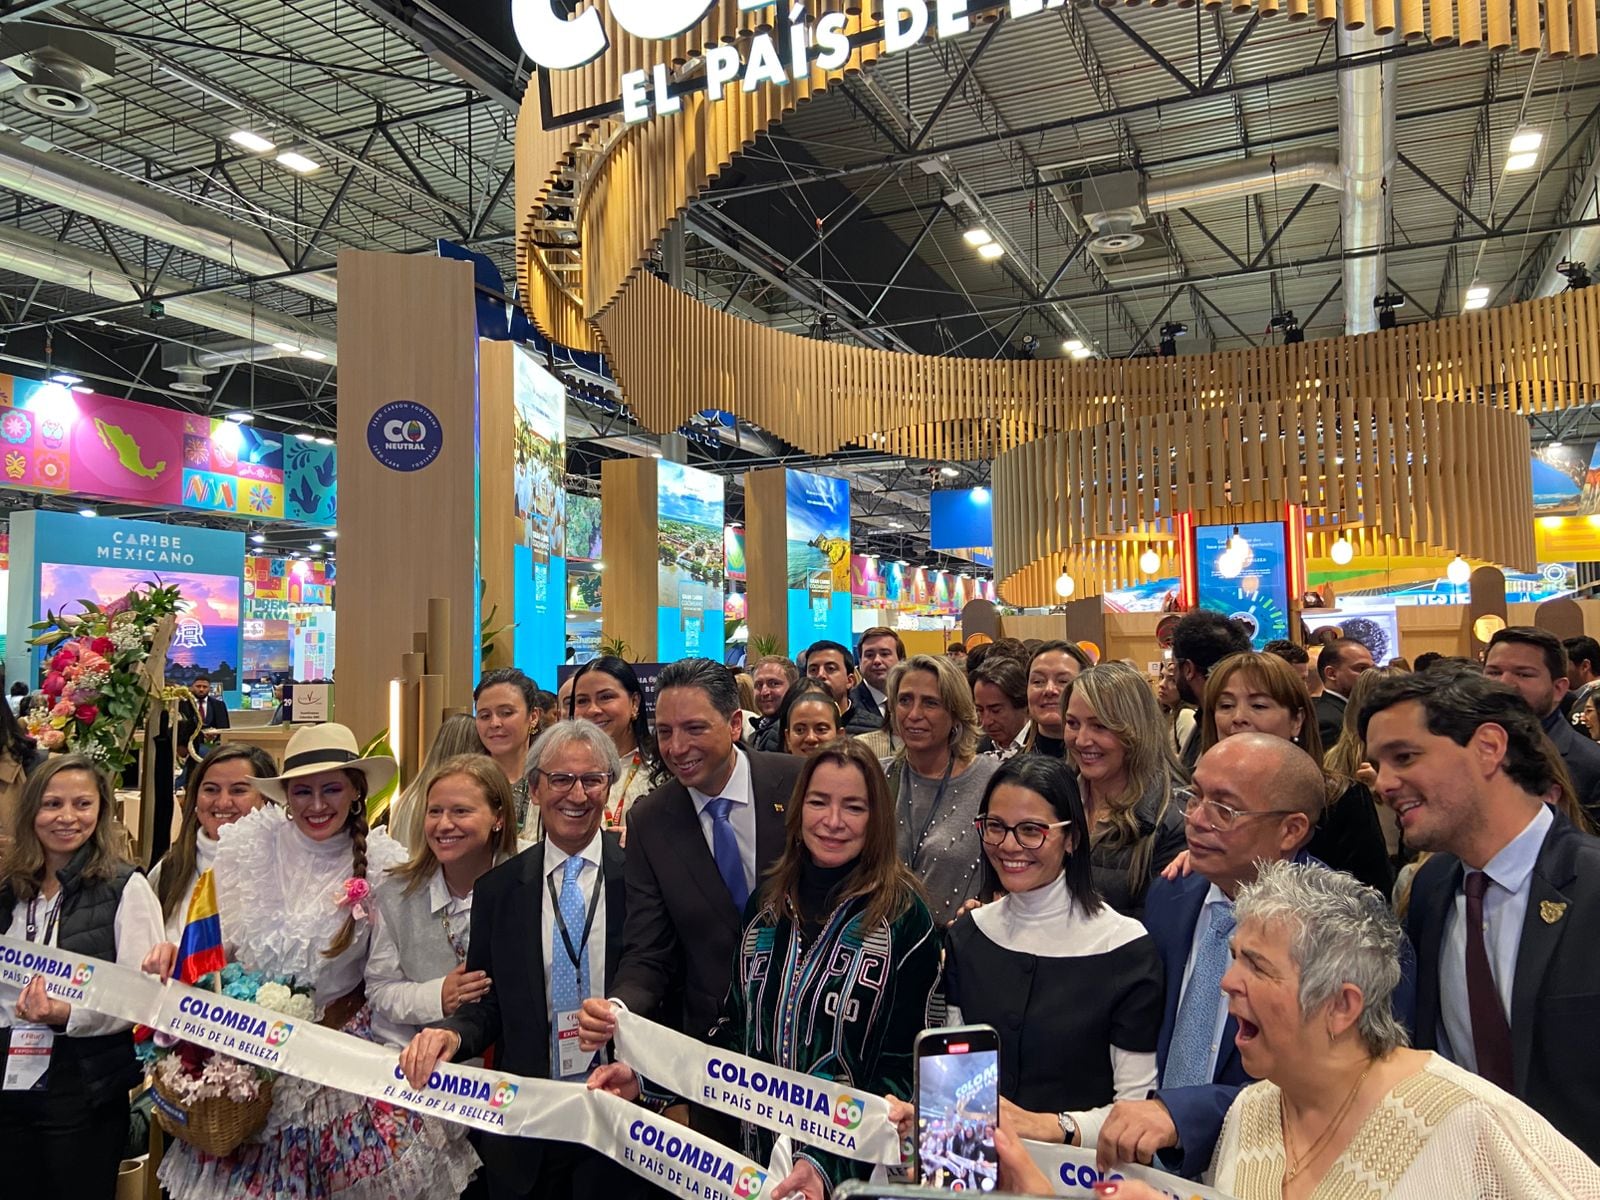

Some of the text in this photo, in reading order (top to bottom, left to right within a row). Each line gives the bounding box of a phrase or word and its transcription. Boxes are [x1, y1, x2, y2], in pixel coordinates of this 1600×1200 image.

[621, 63, 682, 123] EL
[705, 2, 850, 101] PAÍS
[882, 0, 970, 54] DE
[385, 442, 425, 450] NEUTRAL
[97, 545, 194, 565] MEXICANO
[112, 531, 181, 549] CARIBE
[284, 698, 293, 706] 29
[3, 969, 21, 983] PAÍS
[47, 982, 84, 1000] BELLEZA
[179, 995, 268, 1038] COLOMBIA
[170, 1018, 280, 1062] EL PAÍS DE LA BELLEZA
[394, 1064, 491, 1102] COMBIA
[708, 1058, 830, 1116] COLOMBIA
[384, 1085, 504, 1126] EL PAÍS DE LA BELLEZA
[704, 1086, 856, 1150] EL PAÍS DE LA BELLEZA
[624, 1147, 635, 1161] EL
[639, 1154, 664, 1175] PAÍS
[668, 1168, 683, 1185] DE
[686, 1177, 699, 1195] LA
[629, 1120, 735, 1186] COLOMBIA
